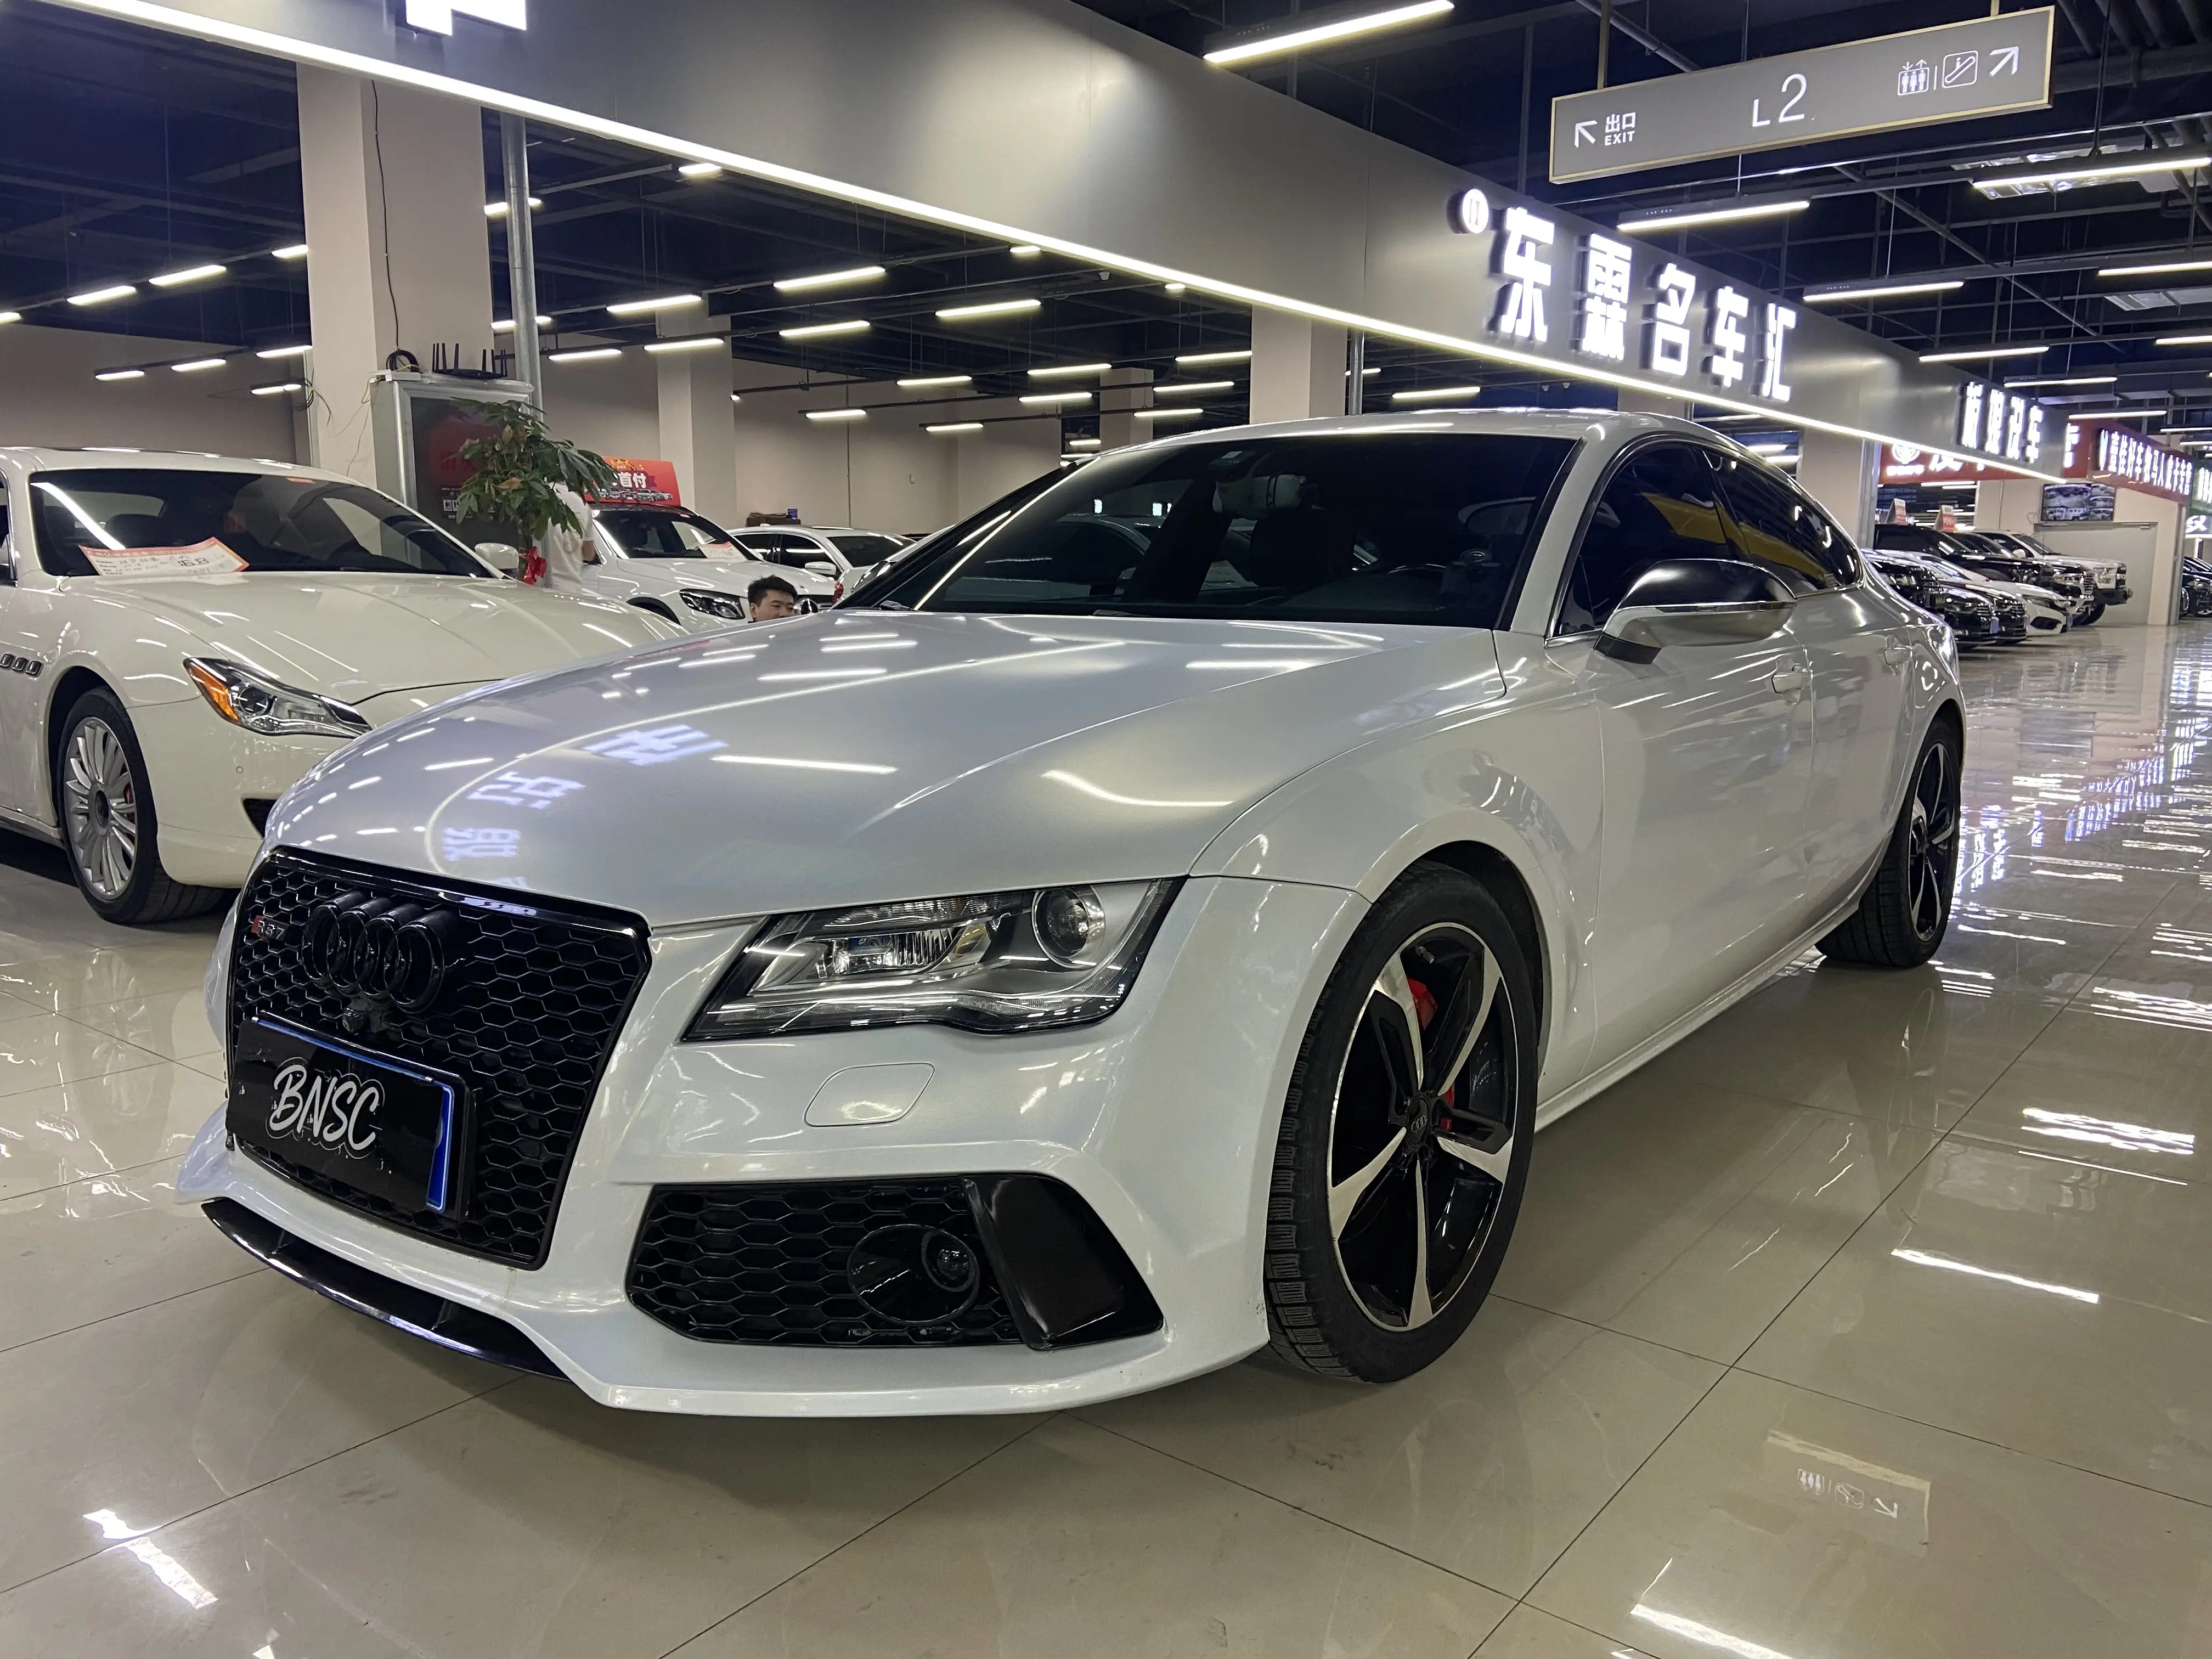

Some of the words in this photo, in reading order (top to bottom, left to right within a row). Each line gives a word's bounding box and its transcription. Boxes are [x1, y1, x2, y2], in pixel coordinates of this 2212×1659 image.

[1605, 112, 1636, 133] 出口
[1605, 131, 1635, 146] EXIT
[1500, 207, 1796, 402] 东霖名车汇
[258, 920, 284, 940] RS7
[269, 1064, 379, 1151] BNSC
